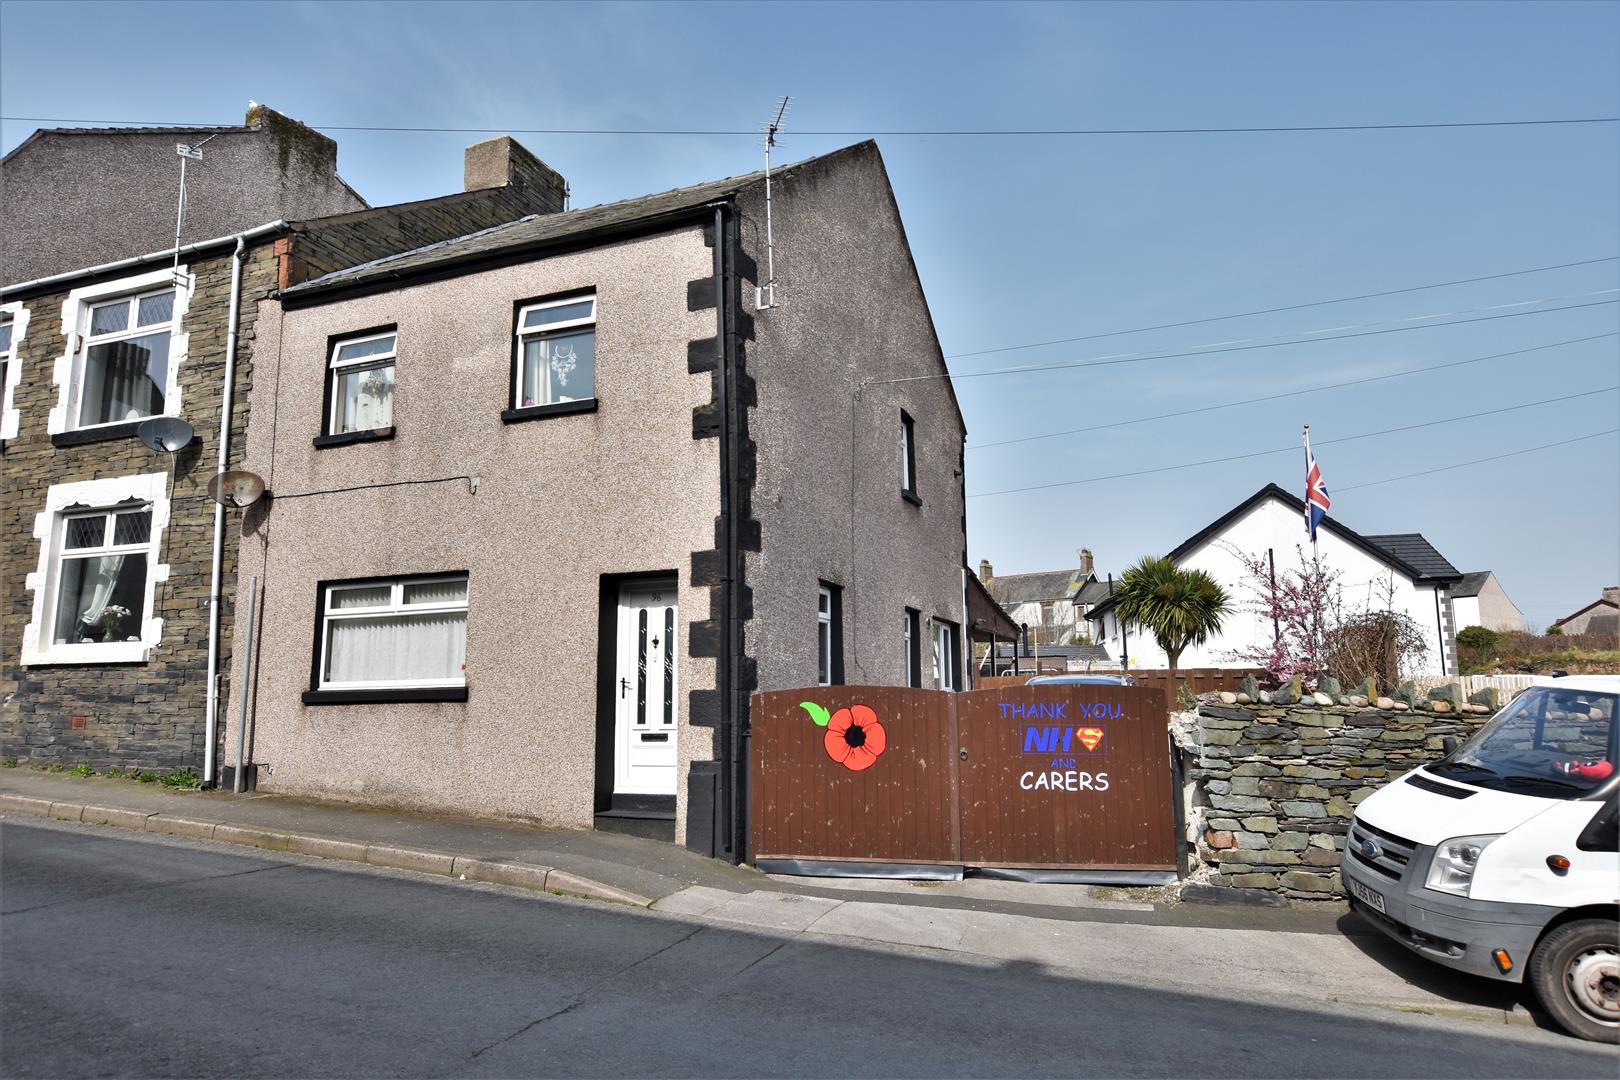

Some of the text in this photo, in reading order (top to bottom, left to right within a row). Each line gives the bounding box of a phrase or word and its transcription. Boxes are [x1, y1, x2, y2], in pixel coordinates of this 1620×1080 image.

[998, 703, 1121, 719] THANK YOU
[1050, 758, 1077, 769] AND
[1020, 770, 1109, 791] CARERS
